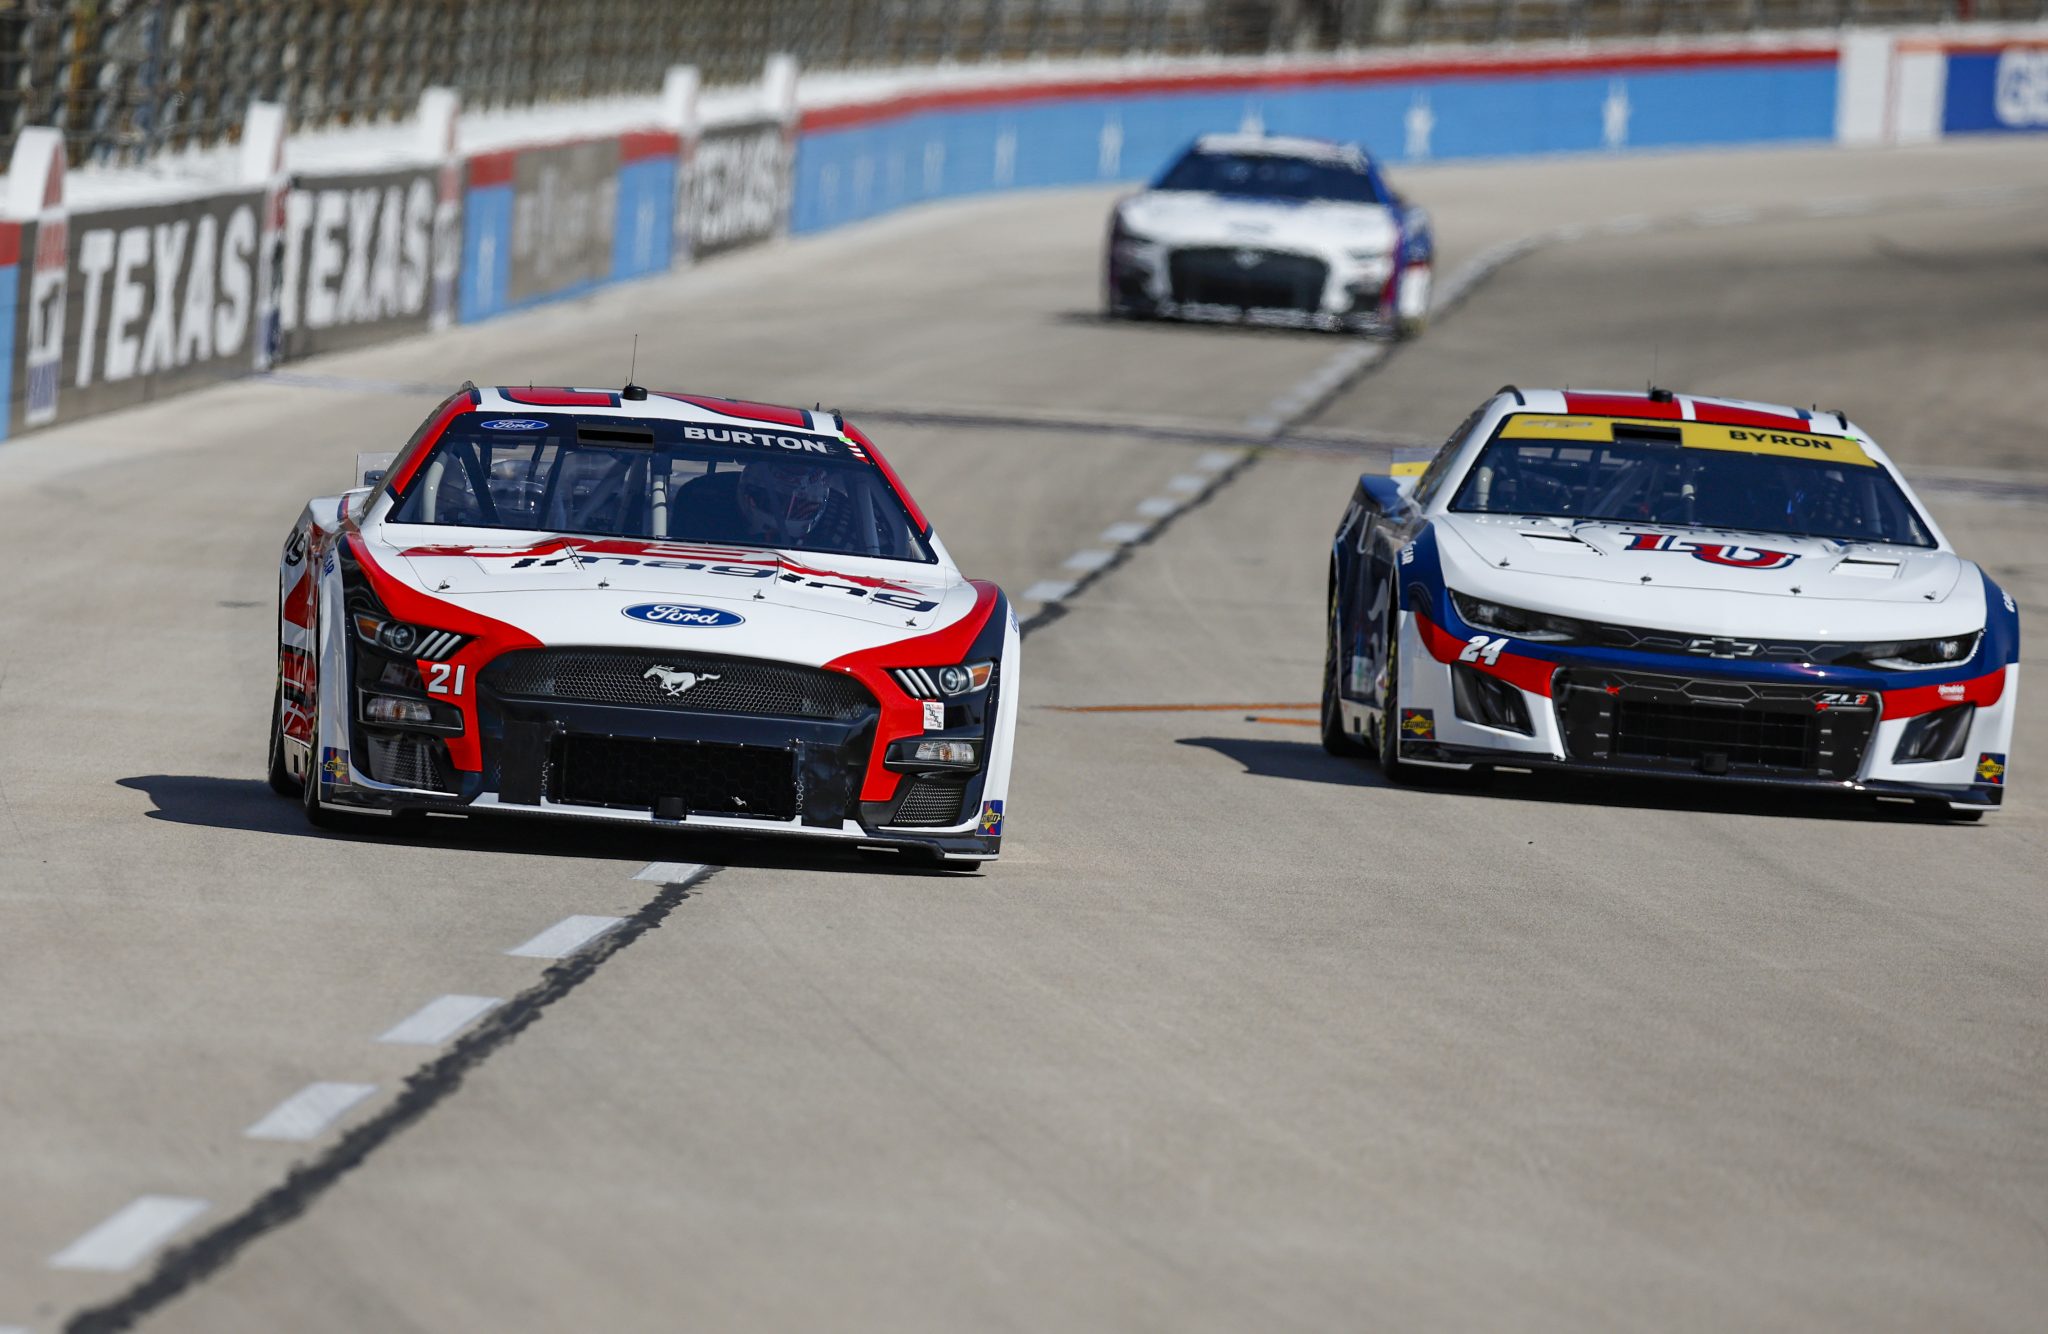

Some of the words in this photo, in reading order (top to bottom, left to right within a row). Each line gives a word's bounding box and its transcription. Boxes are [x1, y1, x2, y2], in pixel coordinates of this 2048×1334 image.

[280, 177, 434, 331] TEXAS
[75, 204, 256, 389] TEXAS
[492, 420, 537, 430] Ford
[683, 426, 828, 454] BURTON
[1729, 430, 1833, 450] BYRON
[645, 604, 721, 625] Ford
[1459, 635, 1510, 666] 24
[428, 663, 466, 695] 21
